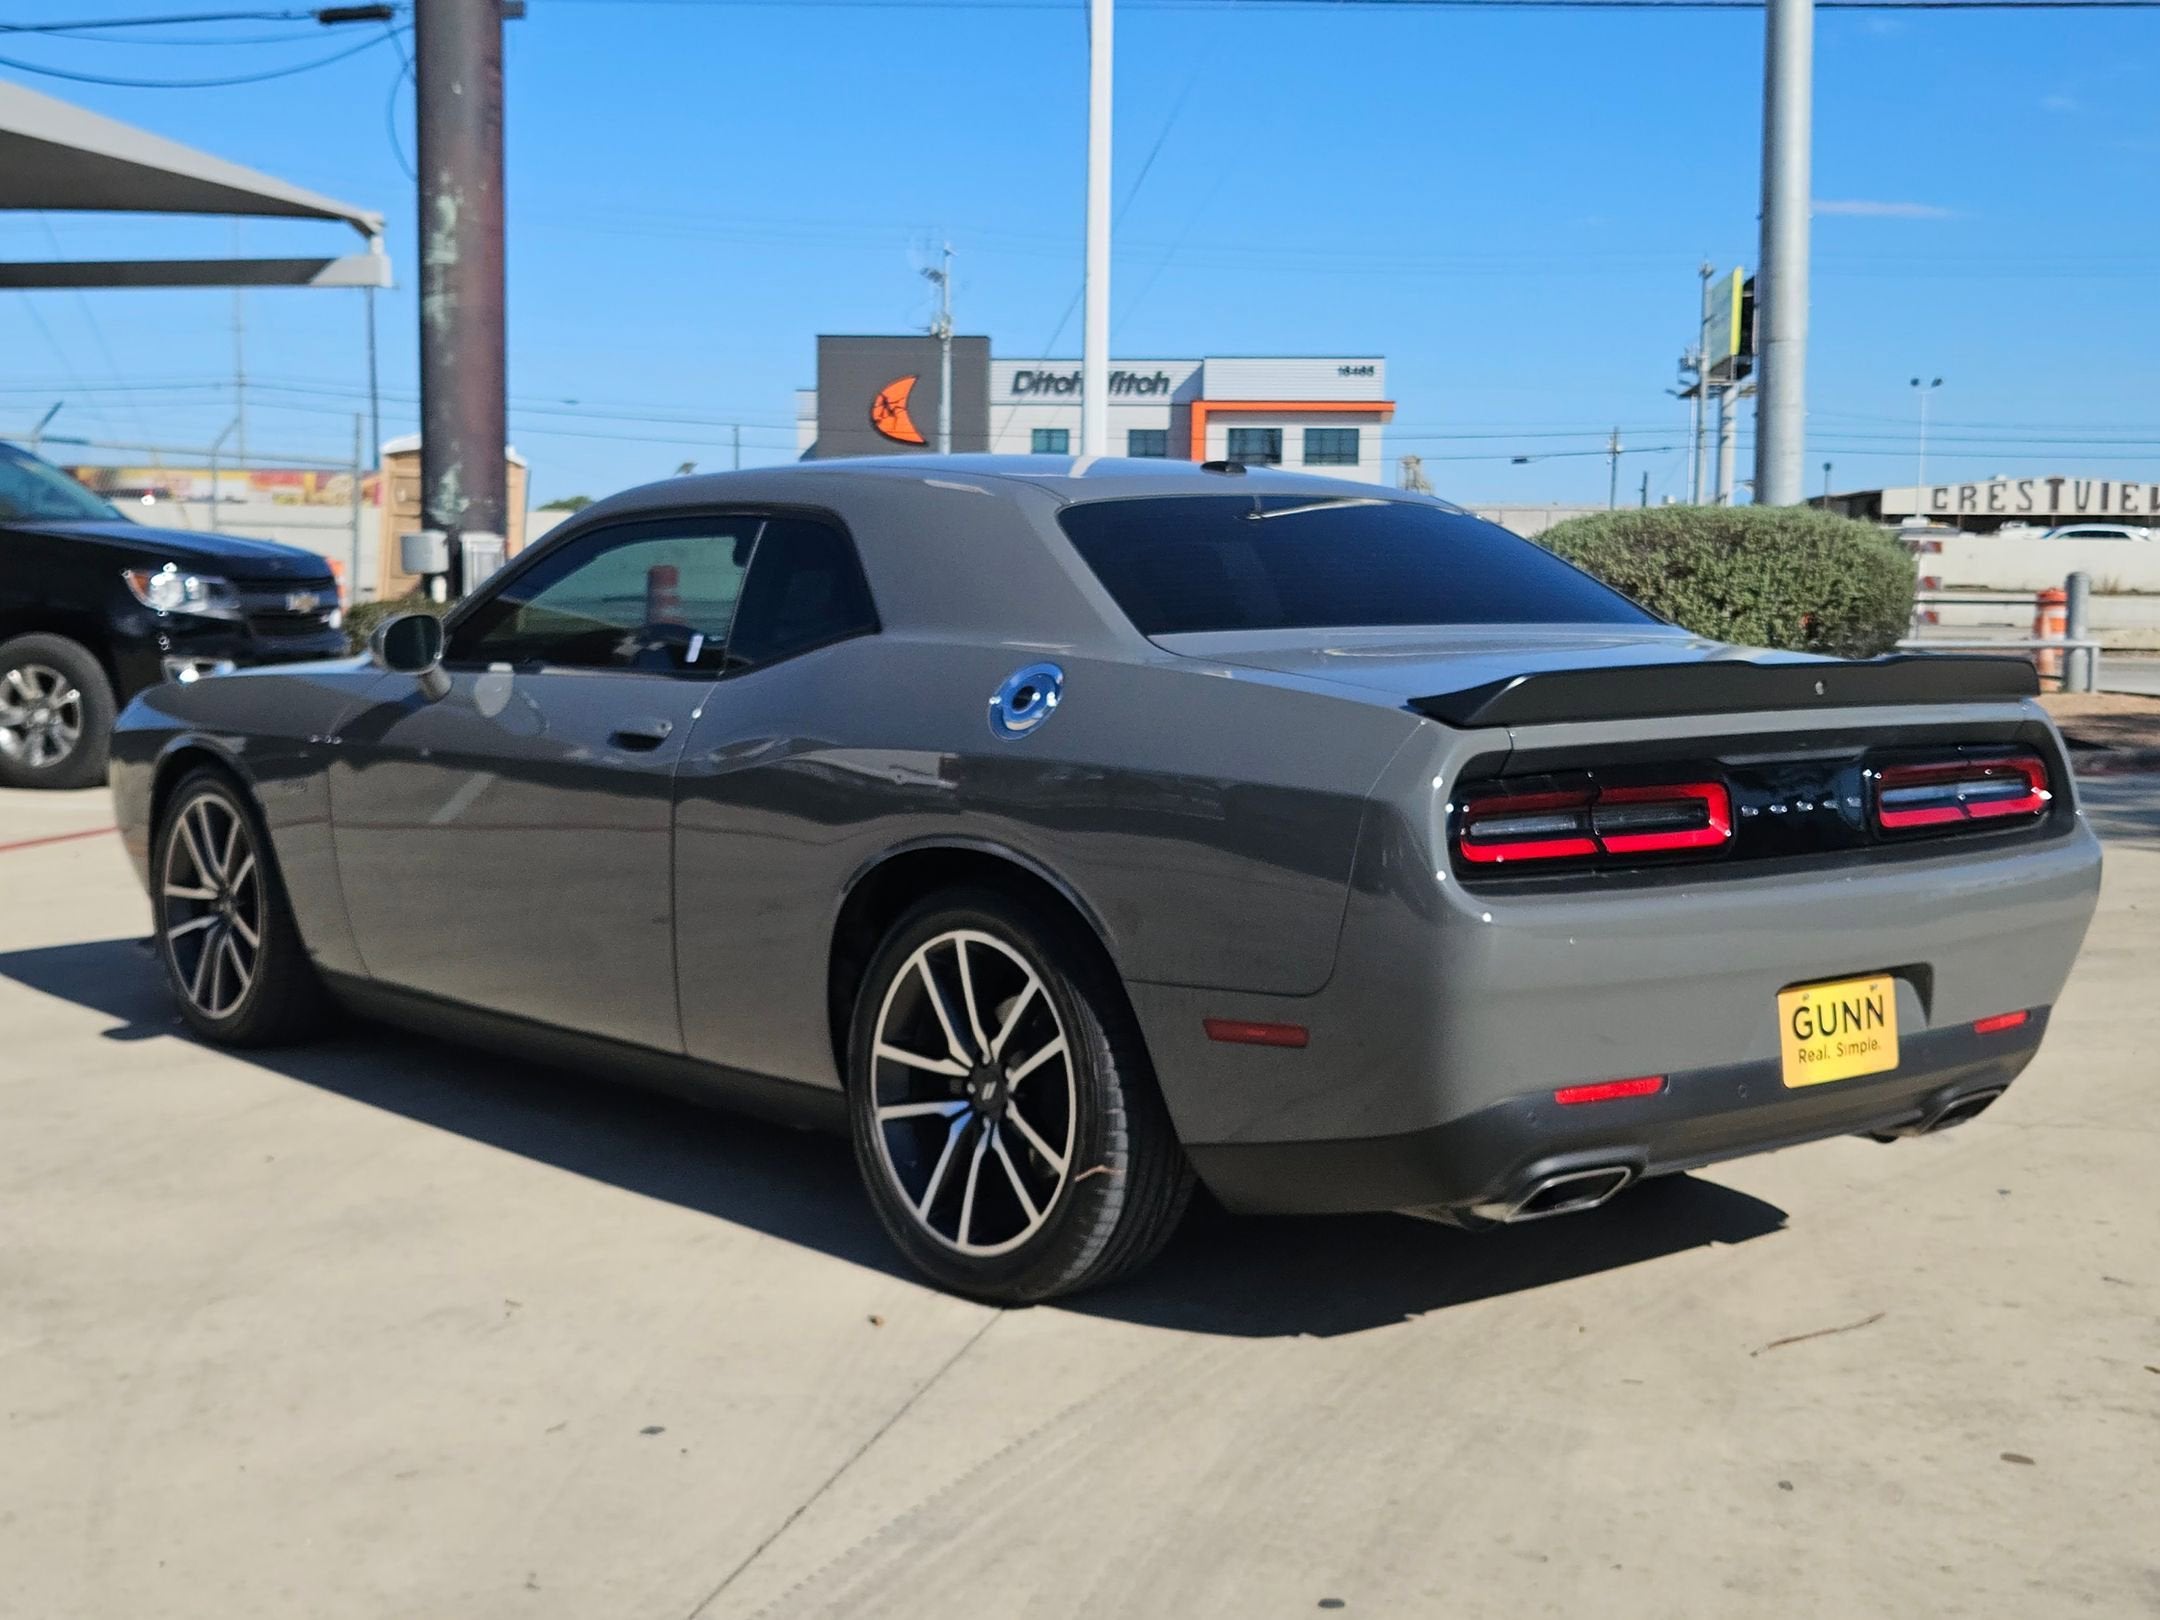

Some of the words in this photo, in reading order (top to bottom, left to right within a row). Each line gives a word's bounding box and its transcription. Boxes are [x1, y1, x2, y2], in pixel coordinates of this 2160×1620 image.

[1792, 994, 1884, 1041] GUNN
[1798, 1044, 1831, 1064] Real.
[1836, 1038, 1881, 1058] Simple.
